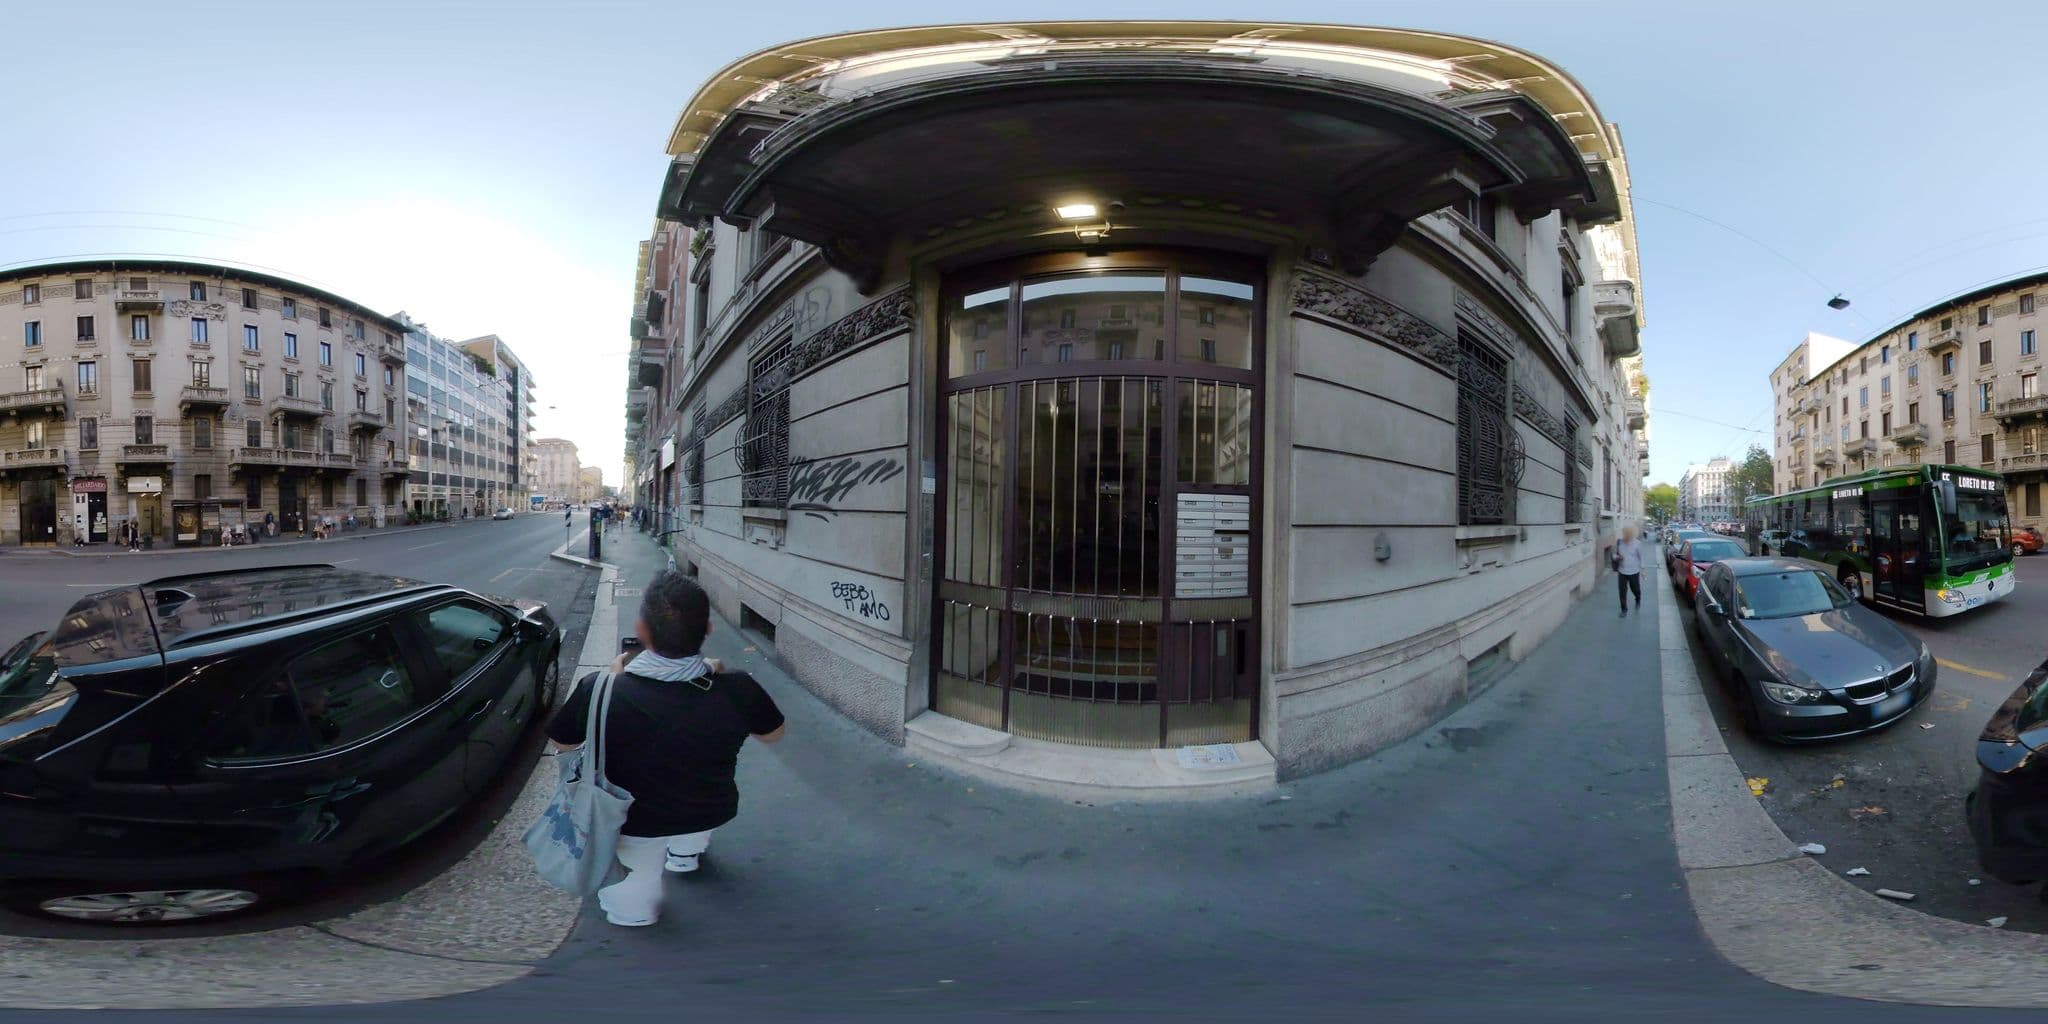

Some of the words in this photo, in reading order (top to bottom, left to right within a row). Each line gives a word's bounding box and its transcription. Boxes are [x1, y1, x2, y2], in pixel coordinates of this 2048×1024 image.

[1958, 476, 1980, 489] LORETO
[844, 598, 854, 612] TI
[860, 600, 890, 621] AMO
